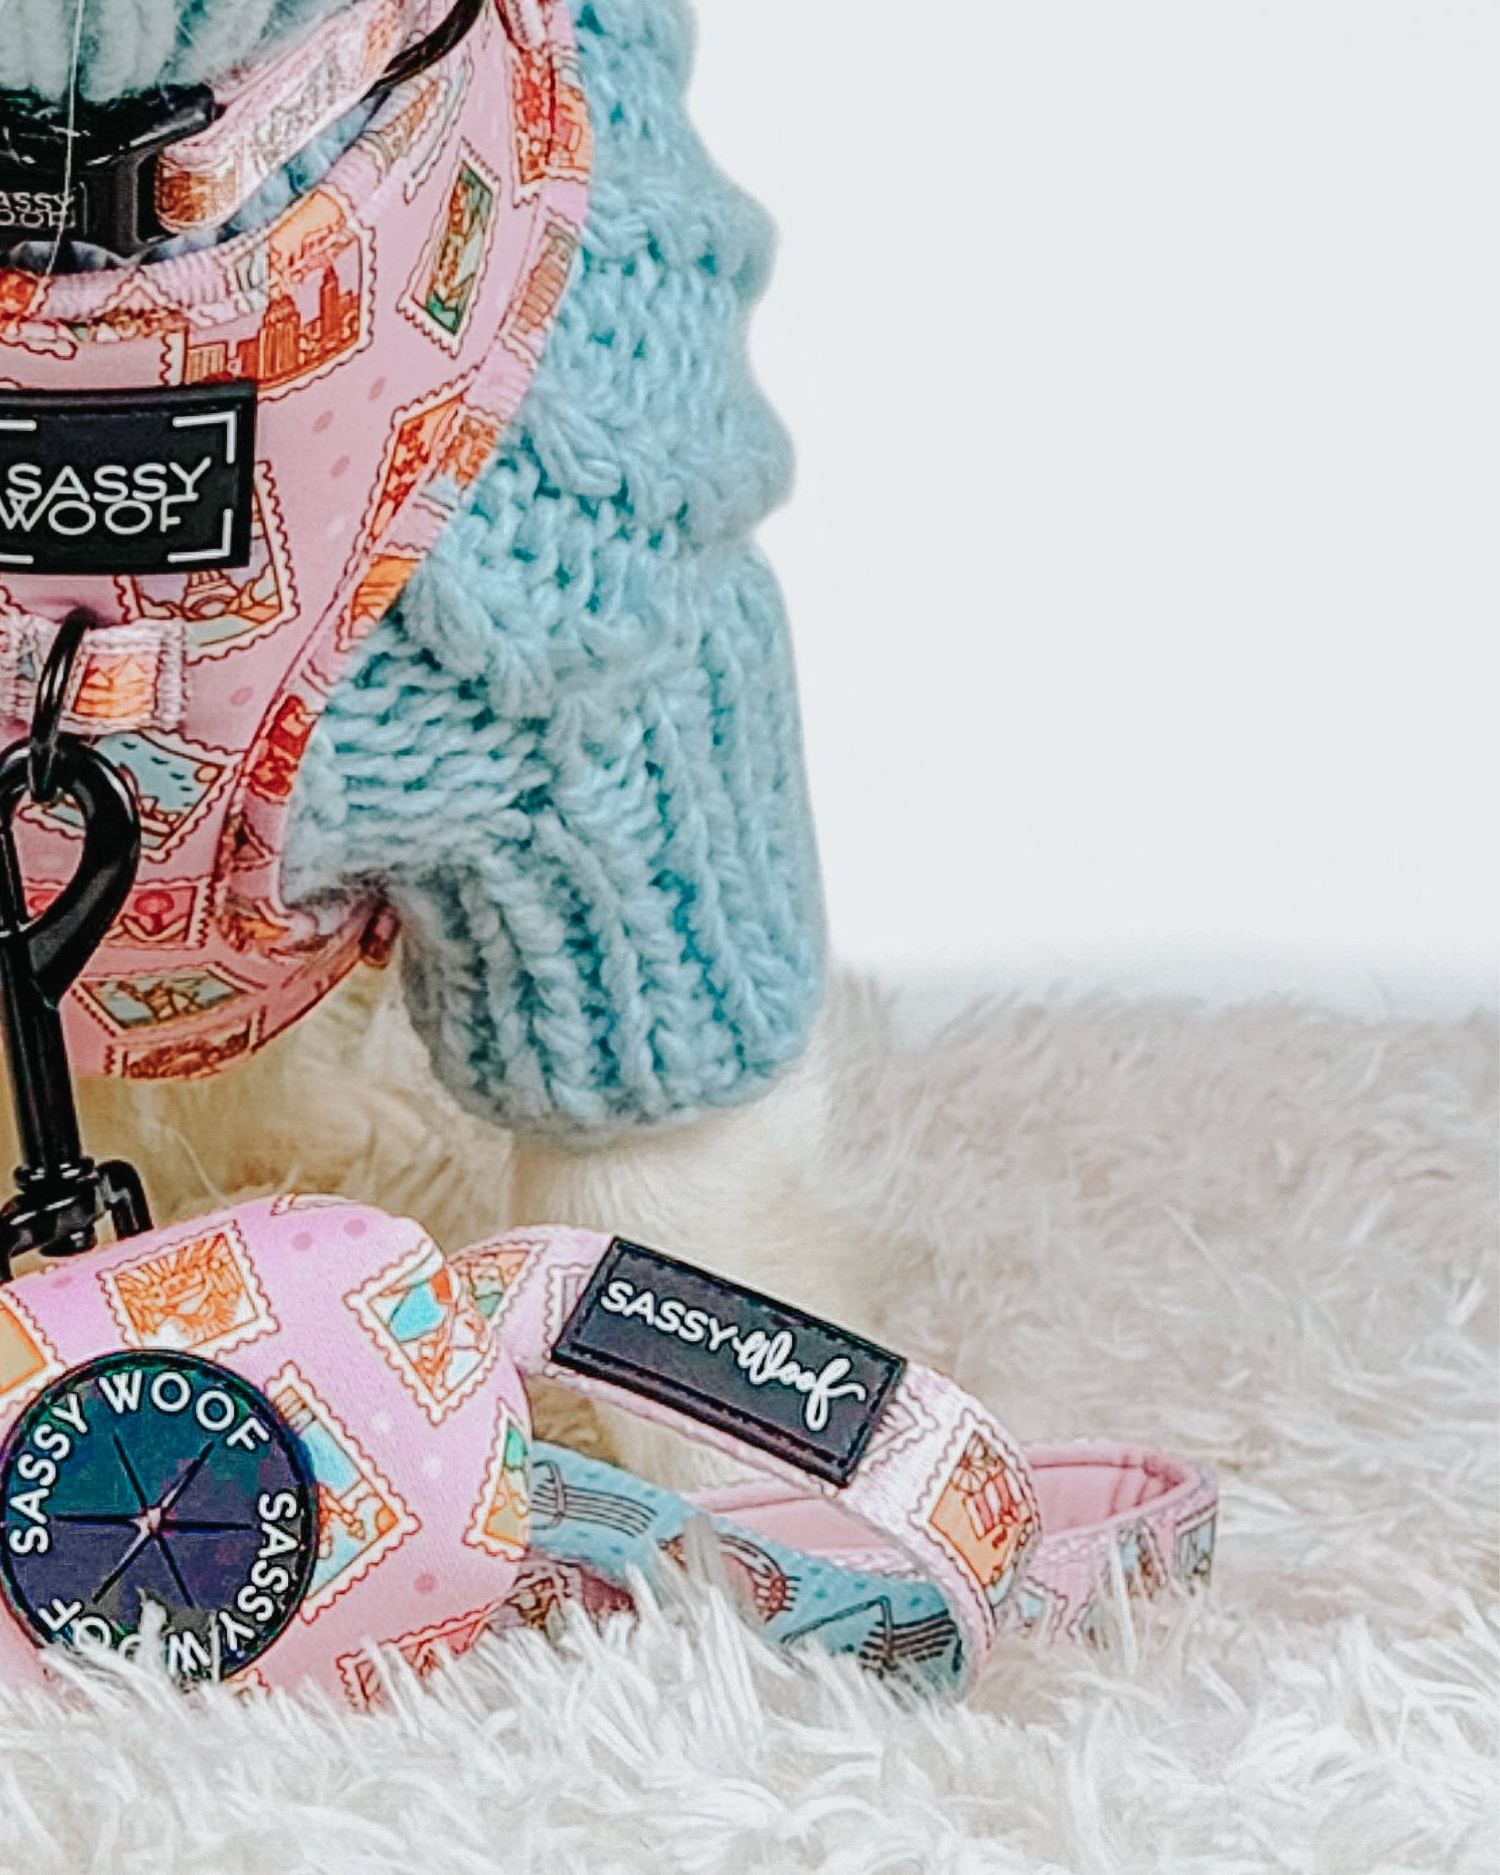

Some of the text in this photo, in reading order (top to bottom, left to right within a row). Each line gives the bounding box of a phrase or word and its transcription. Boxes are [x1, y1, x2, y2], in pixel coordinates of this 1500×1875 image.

[5, 457, 212, 503] SASSY
[600, 1280, 866, 1431] SASSY Woof
[9, 1369, 269, 1555] SASSY WOOF
[218, 1492, 298, 1650] SASSY
